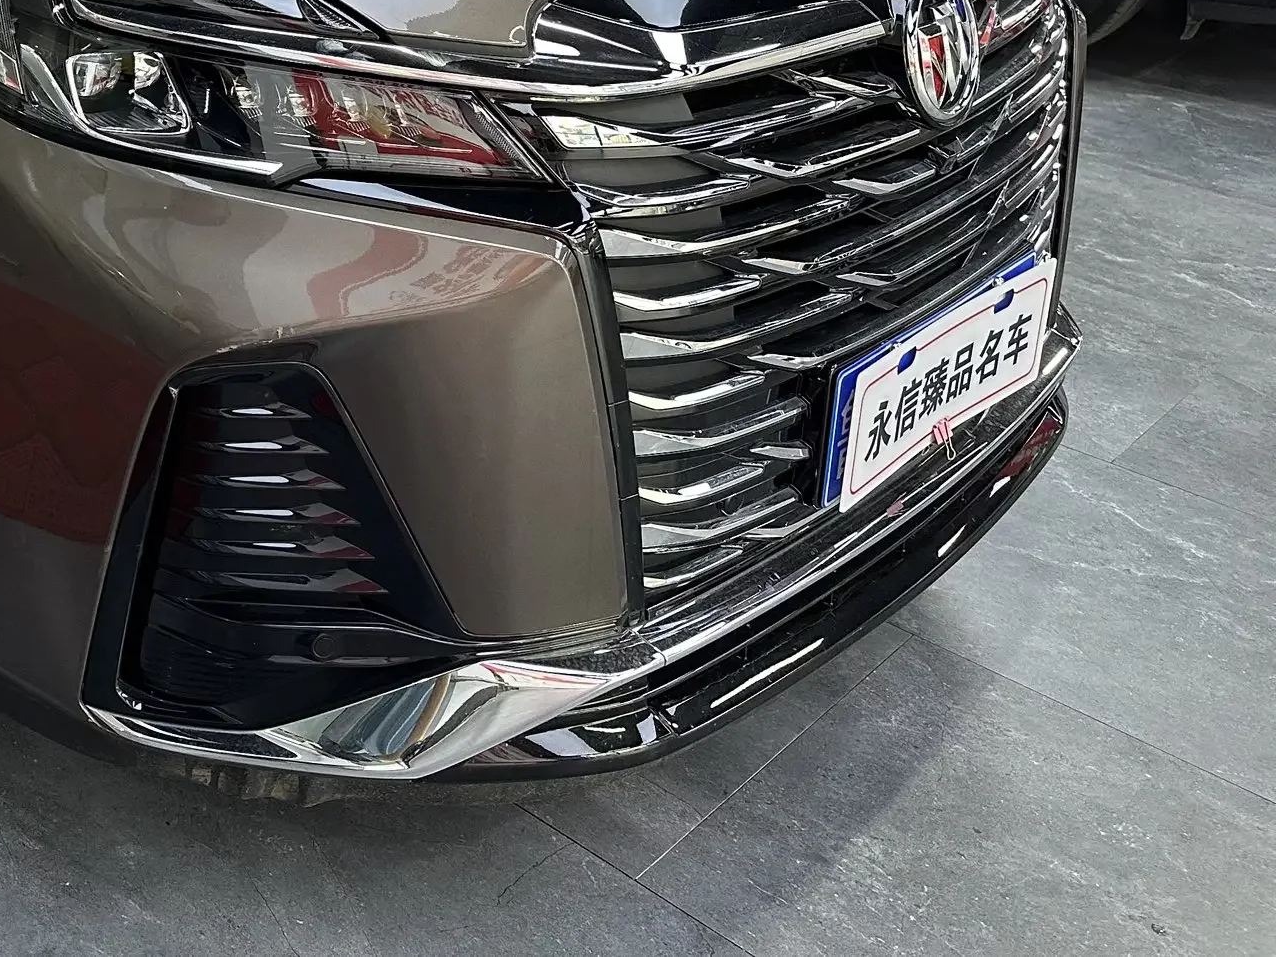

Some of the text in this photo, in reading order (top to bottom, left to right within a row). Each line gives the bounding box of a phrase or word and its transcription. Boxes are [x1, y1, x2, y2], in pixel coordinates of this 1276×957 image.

[864, 314, 1032, 462] 永信臻品名车
